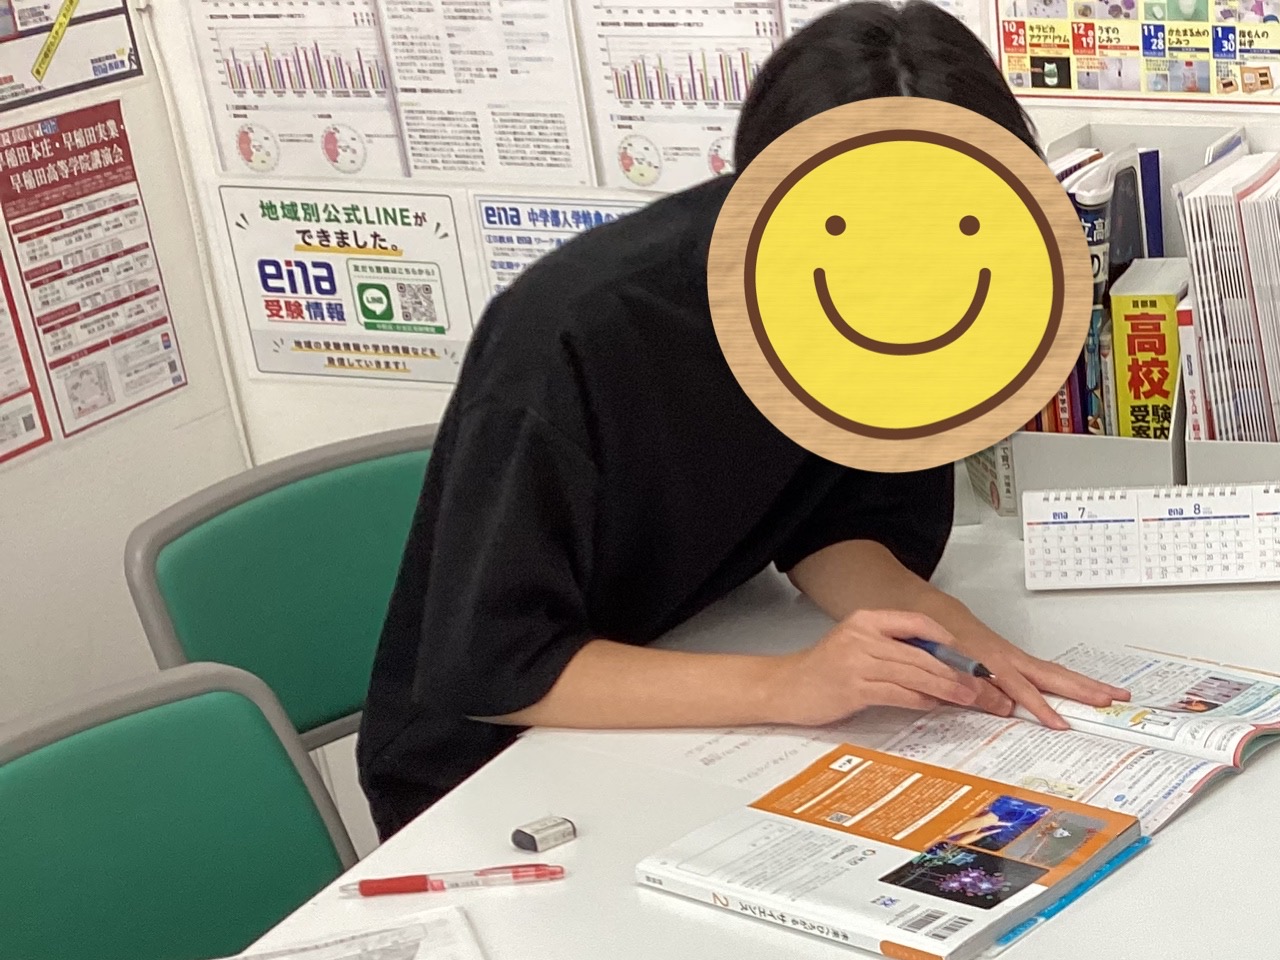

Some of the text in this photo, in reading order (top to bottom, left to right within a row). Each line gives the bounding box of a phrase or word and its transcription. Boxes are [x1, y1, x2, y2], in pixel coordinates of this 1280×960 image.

[1004, 22, 1016, 32] 10
[1073, 24, 1085, 34] 12
[1143, 26, 1154, 36] 11
[1216, 27, 1223, 38] 1
[1012, 35, 1025, 46] 24
[1081, 37, 1094, 47] 19
[1151, 39, 1164, 50] 28
[1222, 40, 1235, 51] 30
[260, 200, 427, 227] 地域別公式LINEが
[485, 206, 521, 226] ena
[296, 229, 398, 251] できました。
[258, 259, 337, 295] ena
[366, 296, 384, 304] LINE
[264, 299, 346, 321] 受験情報
[1124, 312, 1170, 400] 高校
[1078, 507, 1086, 519] 7
[1168, 503, 1201, 516] ena 8
